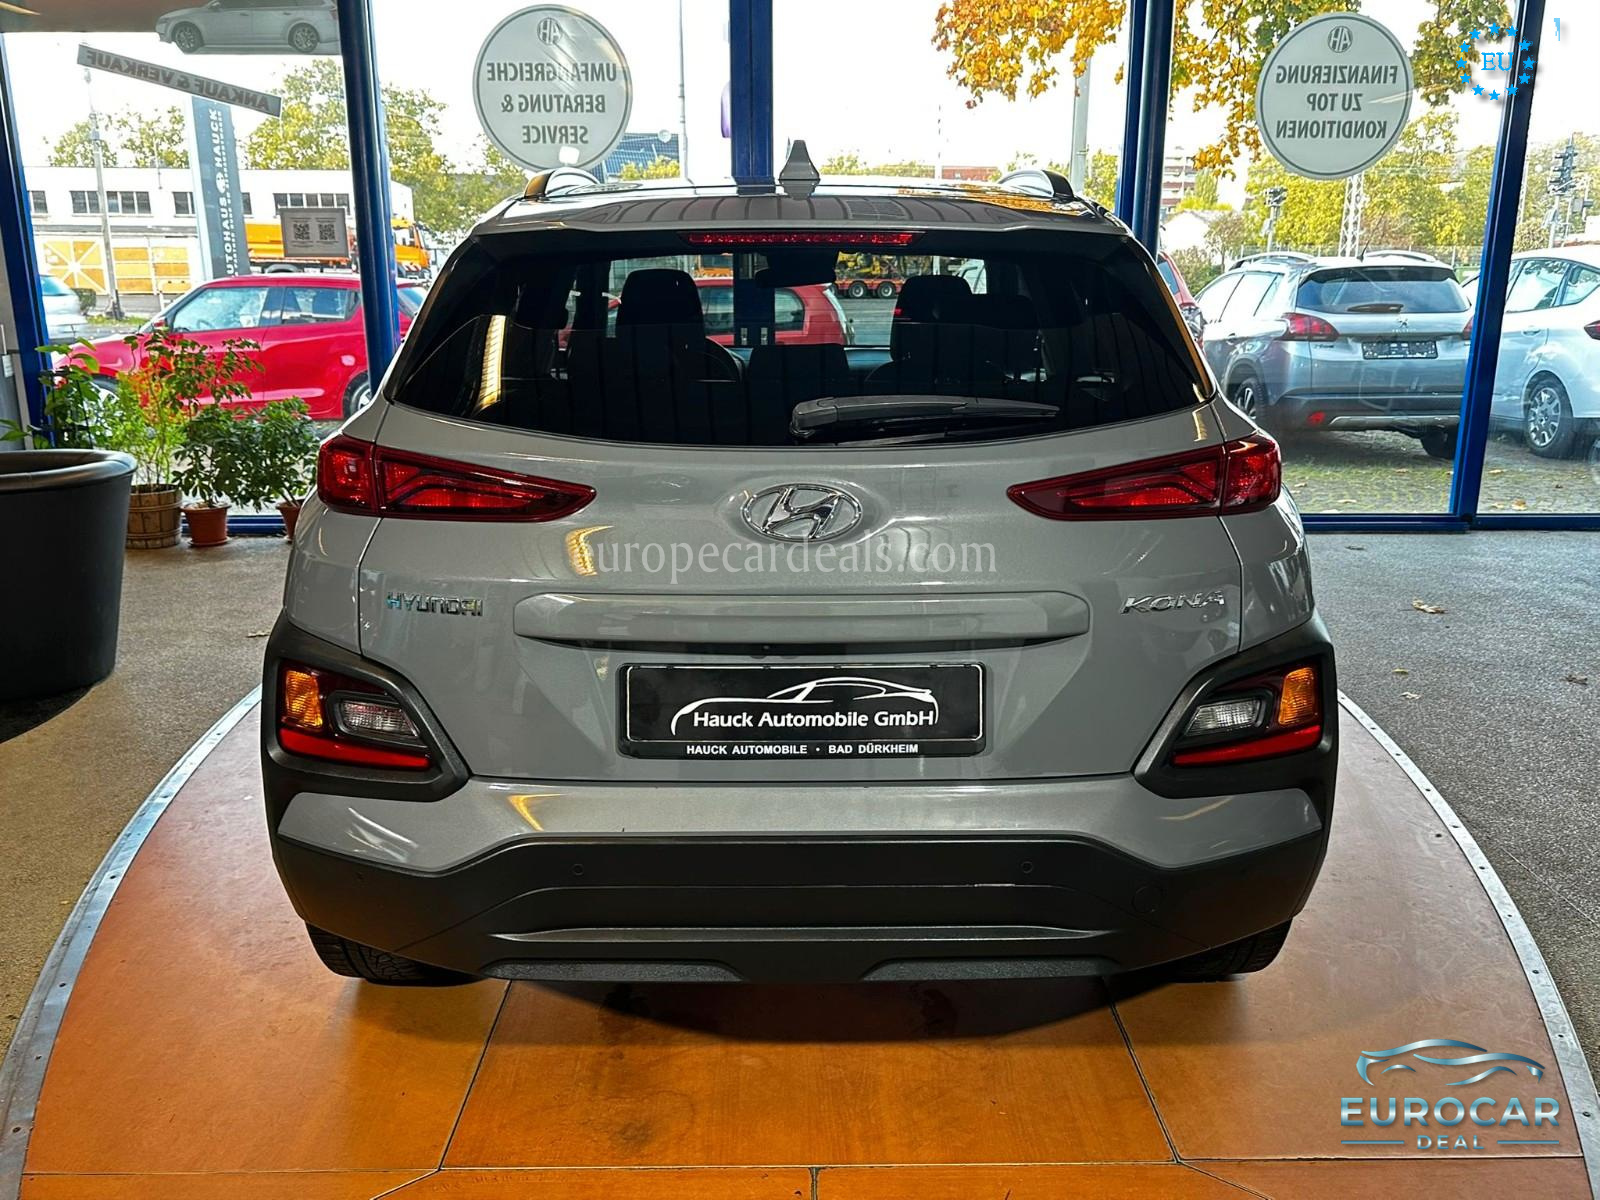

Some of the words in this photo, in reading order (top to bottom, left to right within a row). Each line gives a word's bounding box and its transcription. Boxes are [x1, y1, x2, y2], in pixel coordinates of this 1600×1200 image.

[208, 108, 223, 168] HAUCK
[219, 196, 236, 278] UTOHAUS
[387, 592, 483, 616] HYUNDAI
[1121, 590, 1225, 614] KONA
[693, 712, 752, 727] Hauck
[757, 711, 869, 727] Automobile
[874, 711, 934, 726] GmbH
[686, 744, 727, 755] HAUCK
[732, 744, 808, 755] AUTOMOBILE
[828, 744, 853, 754] BAD
[858, 742, 918, 754] DÜRKHEIM
